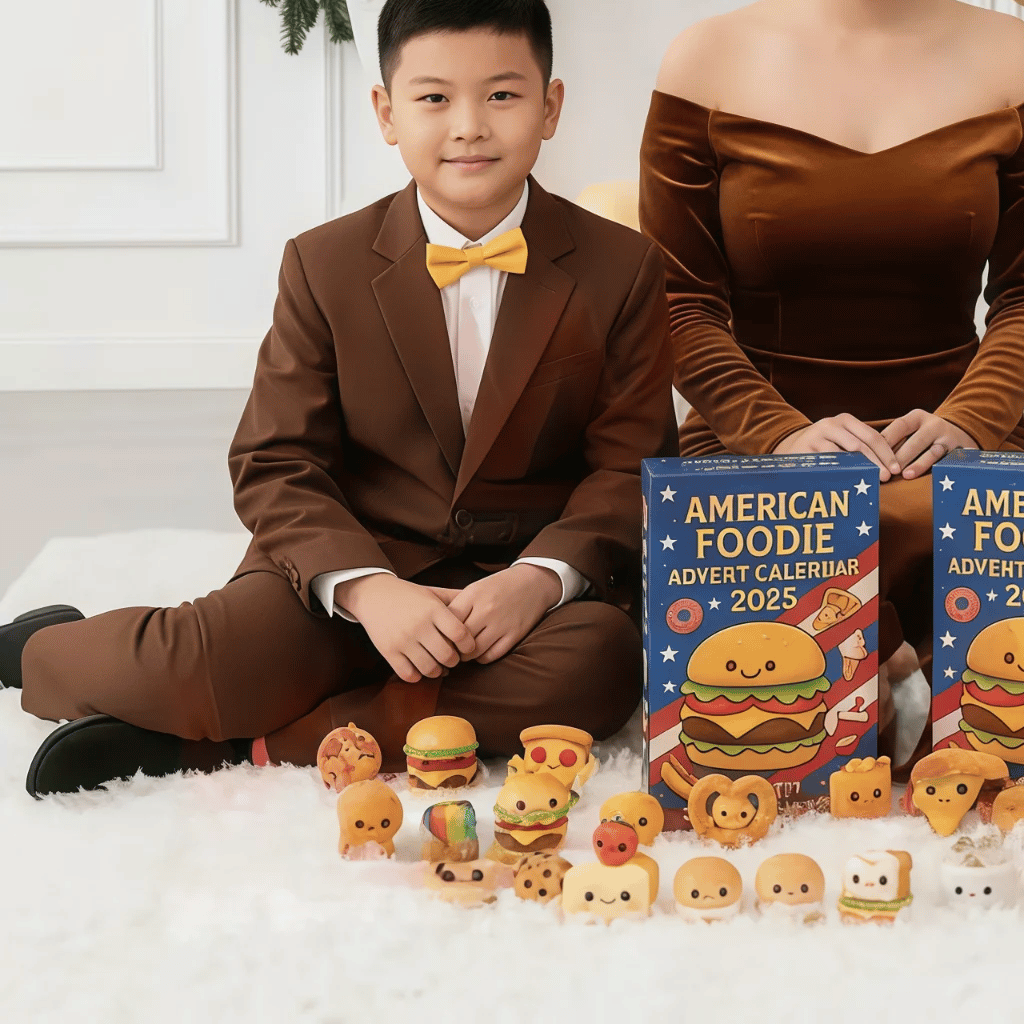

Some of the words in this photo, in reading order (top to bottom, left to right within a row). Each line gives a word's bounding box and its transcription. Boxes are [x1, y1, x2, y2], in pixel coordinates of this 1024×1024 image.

[684, 490, 850, 524] AMERICAN
[696, 522, 835, 559] FOODIE
[668, 565, 750, 586] ADVERT
[730, 586, 798, 612] 2025
